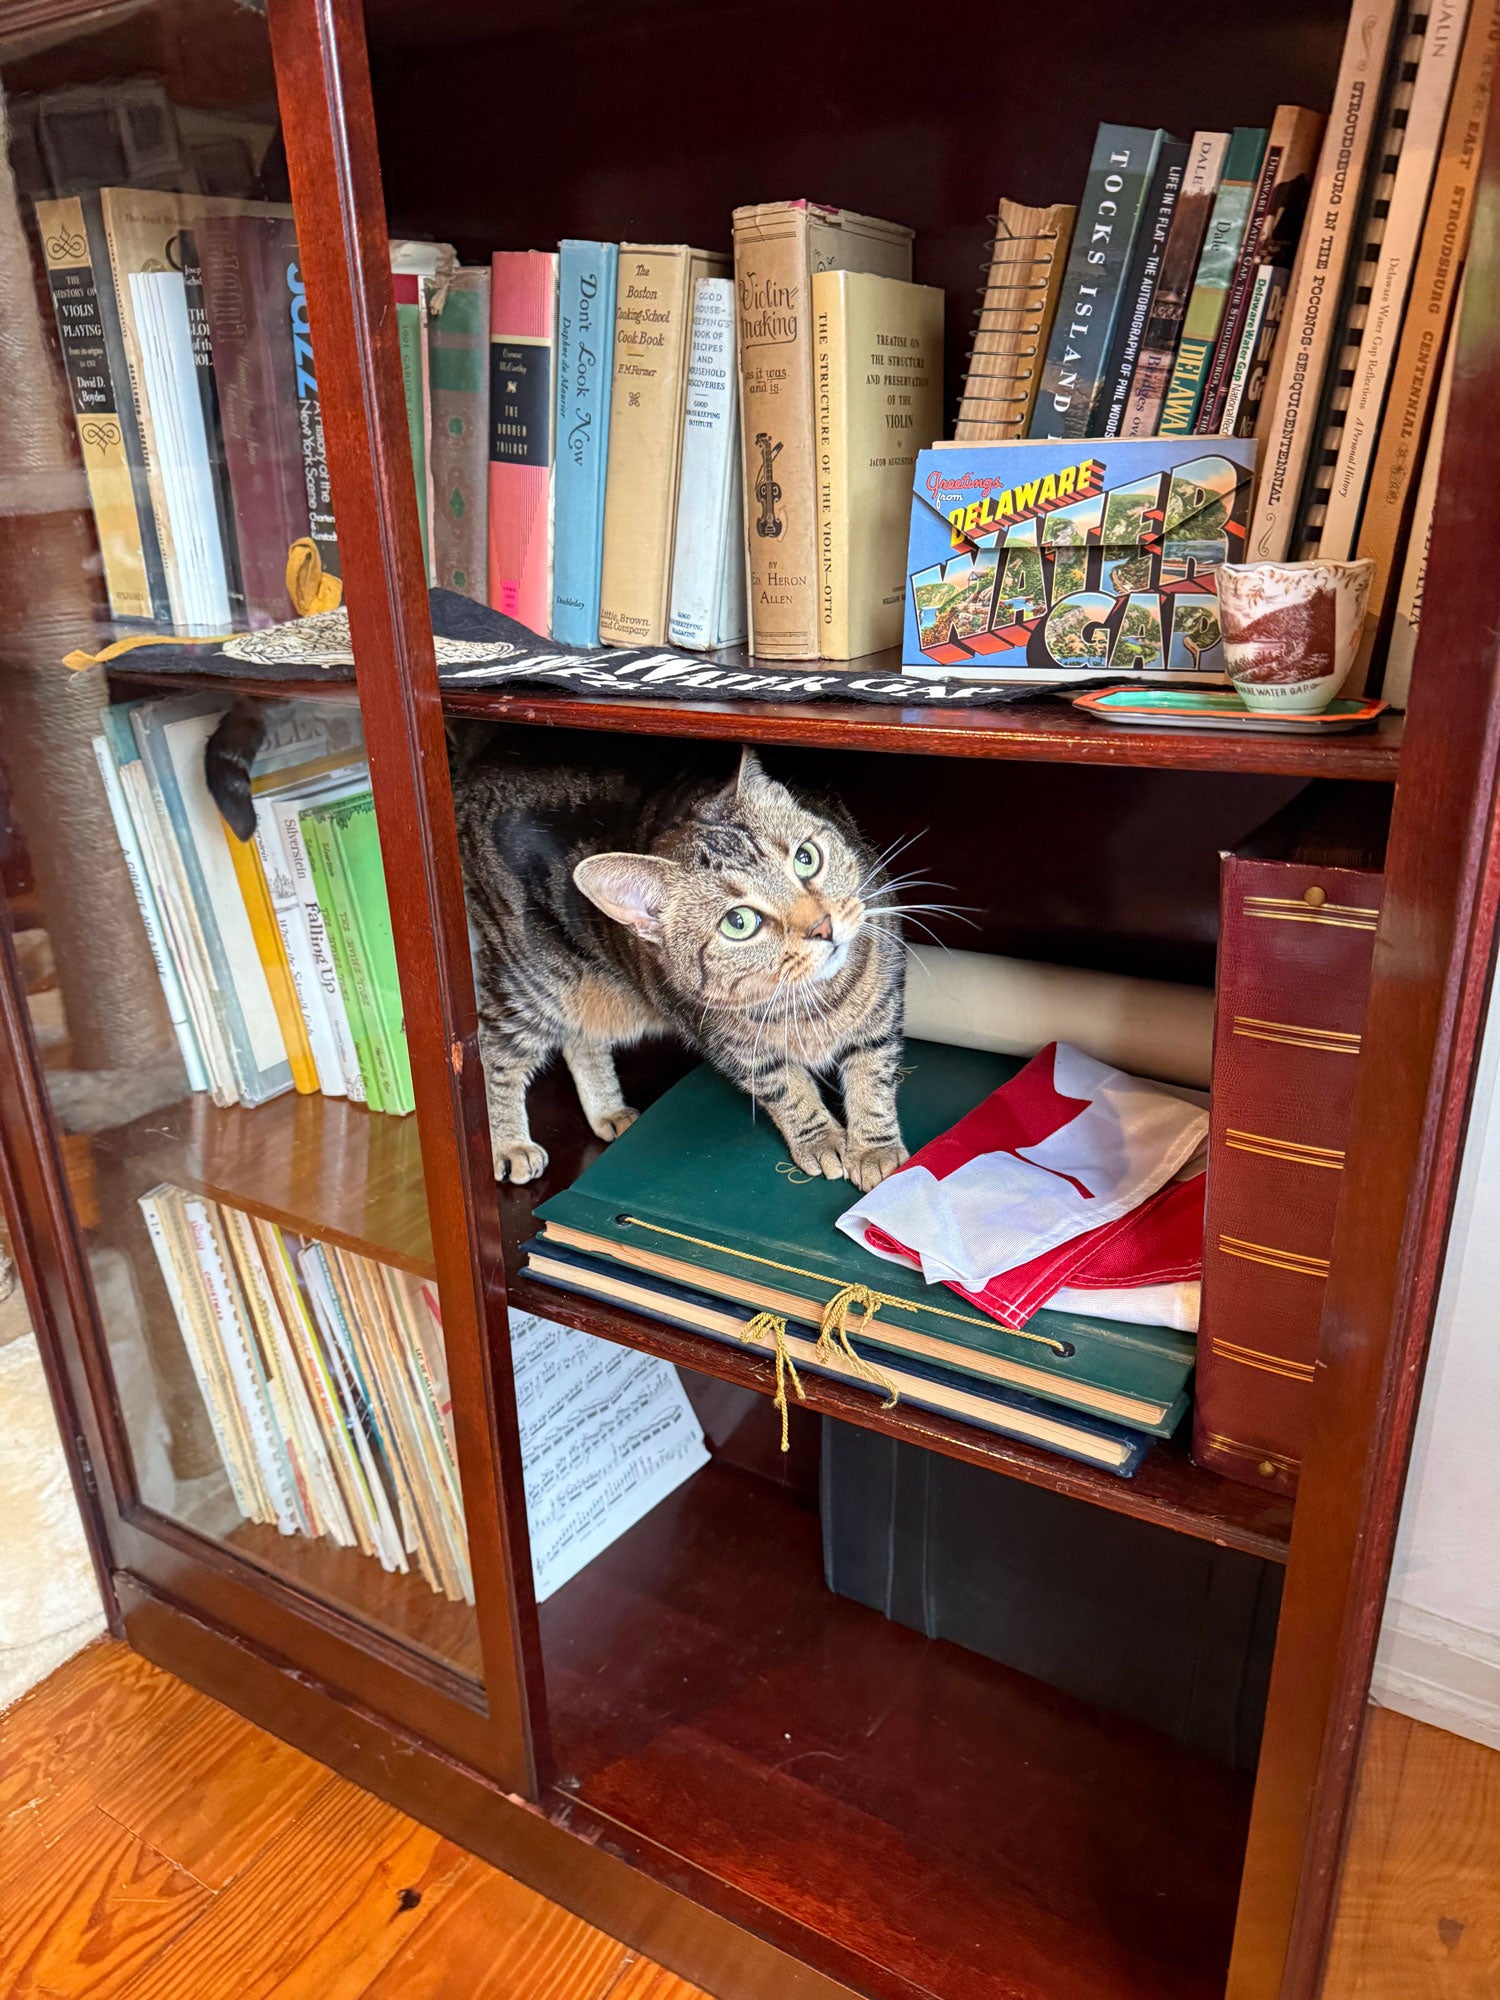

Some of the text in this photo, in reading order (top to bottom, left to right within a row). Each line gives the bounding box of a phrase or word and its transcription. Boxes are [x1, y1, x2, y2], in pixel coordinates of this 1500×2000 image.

[1326, 79, 1367, 206] STROUDSBURG
[1256, 154, 1279, 213] DELAWARE
[1323, 209, 1339, 231] IN
[1212, 221, 1231, 252] Dale
[1245, 215, 1263, 254] WATER
[1314, 233, 1333, 270] THE
[65, 276, 80, 285] THE
[636, 264, 650, 276] The
[1399, 120, 1480, 439] EAST STROUDSBURG CENTENNIAL
[626, 285, 658, 299] Boston
[1053, 150, 1130, 415] TOCKS ISLAND
[699, 292, 722, 301] GOOD
[1103, 164, 1182, 440] LIFE IN E FLAT THE AUTOBIOGRAPHY OF PHIL WOODS
[1245, 278, 1267, 329] Delaware
[62, 304, 94, 317] VIOLIN
[62, 324, 102, 338] PLAYING
[562, 317, 571, 356] Daphne
[618, 330, 665, 347] Cook Book
[693, 330, 723, 340] BOOK OF
[740, 310, 797, 346] making
[818, 312, 828, 345] THE
[693, 342, 723, 353] RECIPES
[876, 334, 920, 348] TREATISE ON
[1208, 307, 1238, 388] STROUDSBURGS,
[1239, 328, 1254, 360] Water
[568, 273, 597, 466] Don't Look Now
[697, 355, 713, 364] AND
[871, 354, 925, 368] THE STRUCTURE
[77, 376, 106, 388] David D.
[755, 367, 763, 379] it
[866, 374, 929, 387] AND PRESERVATION
[1230, 360, 1247, 382] Gap
[1337, 256, 1399, 498] Delaware Water Gap Reflections A Personal History
[81, 390, 106, 405] Boyden
[560, 376, 569, 418] Maurier
[750, 381, 767, 394] and
[693, 400, 708, 408] GOOD
[819, 353, 830, 446] STRUCTURE
[887, 395, 912, 406] OF THE
[1224, 382, 1242, 418] National
[300, 400, 312, 435] New
[505, 405, 518, 418] THE
[885, 414, 914, 429] VIOLIN
[303, 436, 317, 465] York
[496, 441, 528, 456] TRILOGY
[821, 454, 831, 474] OF
[869, 458, 886, 467] JACOB
[305, 467, 318, 509] Scene
[320, 481, 331, 503] the
[822, 482, 831, 513] THE
[926, 471, 1003, 509] Greetings from
[949, 458, 1098, 547] DELAWARE
[911, 455, 1240, 650] WATER
[769, 561, 778, 569] BY
[768, 573, 807, 586] HERON
[556, 595, 585, 610] Doubleday
[760, 591, 793, 604] ALLEN
[613, 623, 650, 637] Company
[1044, 591, 1222, 669] GAP
[614, 654, 1004, 699] WATER GAP
[1256, 684, 1312, 697] WATER GAP
[283, 817, 338, 995] Silverstein Falling Up
[204, 1269, 223, 1321] CHRISTMAS
[414, 1347, 424, 1360] LET
[419, 1363, 427, 1373] US
[423, 1376, 434, 1397] HAVE
